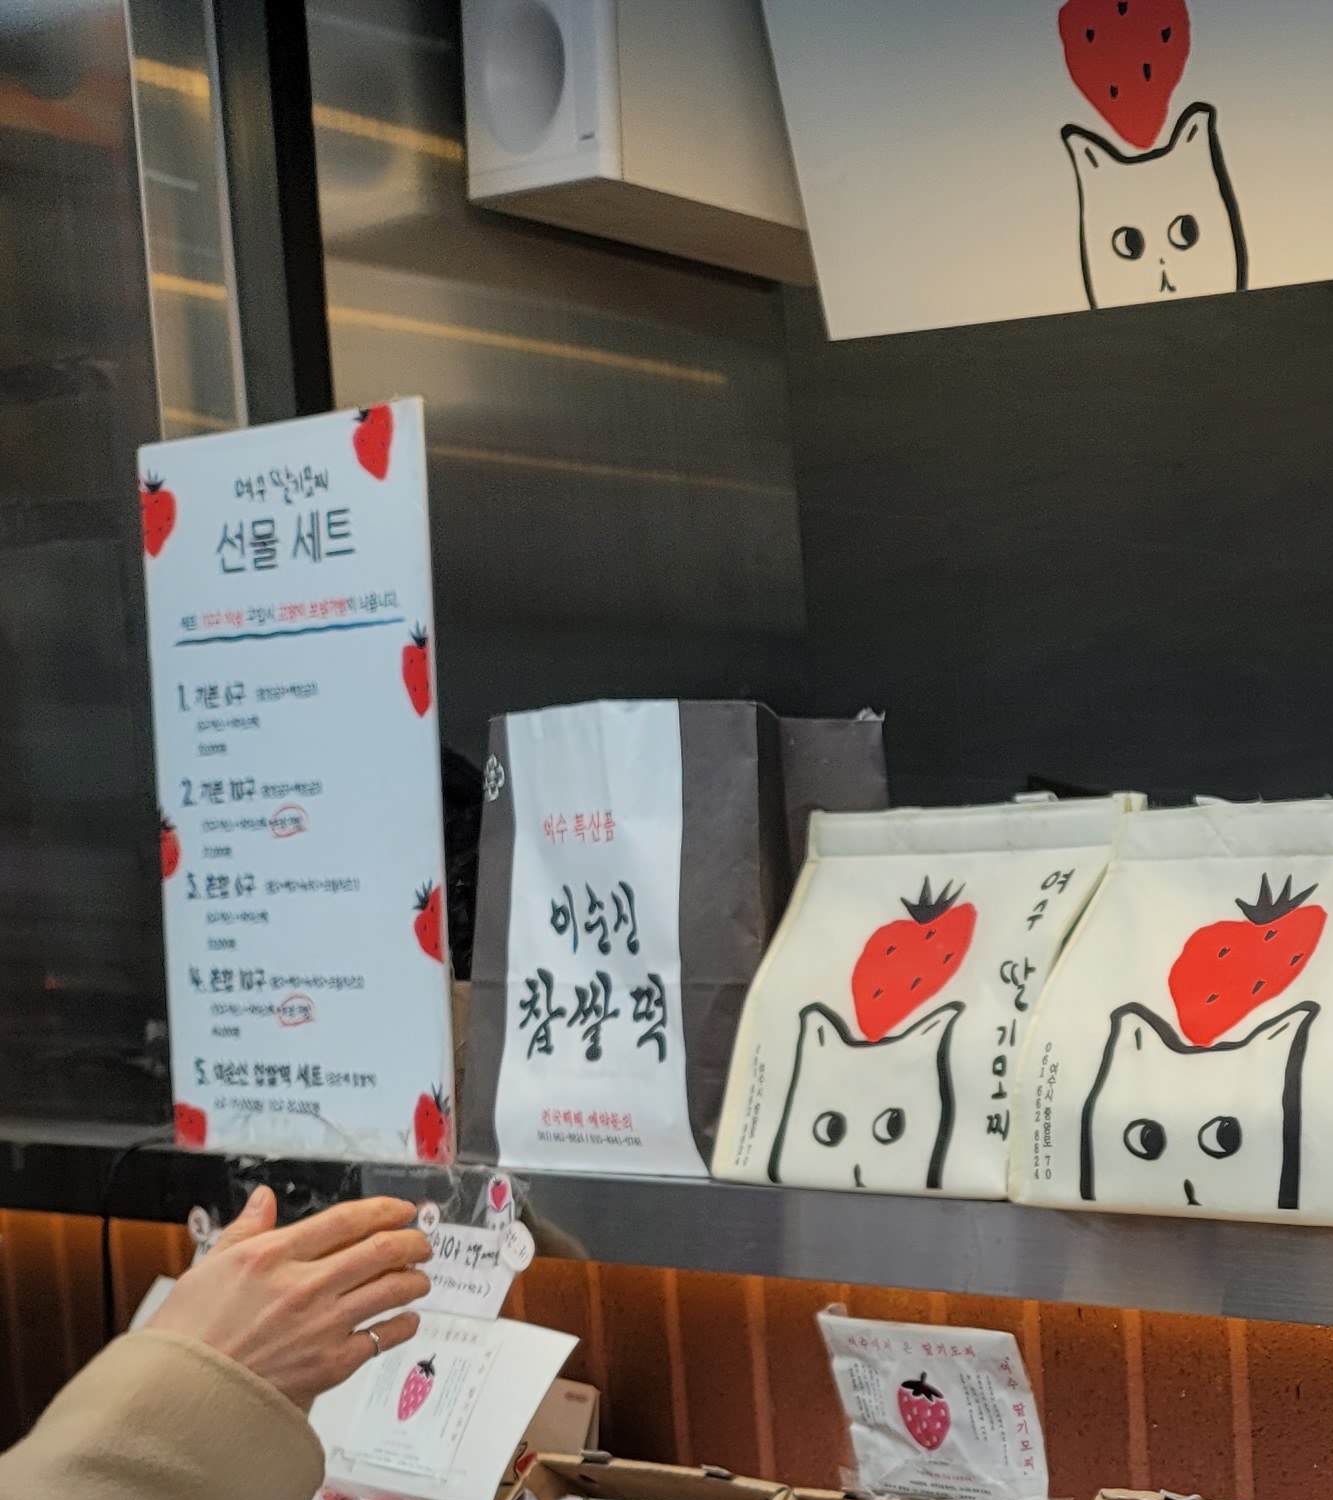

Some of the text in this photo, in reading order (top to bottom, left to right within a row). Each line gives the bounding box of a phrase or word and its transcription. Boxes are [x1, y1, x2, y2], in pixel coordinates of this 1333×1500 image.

[216, 508, 355, 575] 선물 세트
[543, 809, 617, 845] 여수 특산품
[519, 967, 668, 1063] 찹쌀떡
